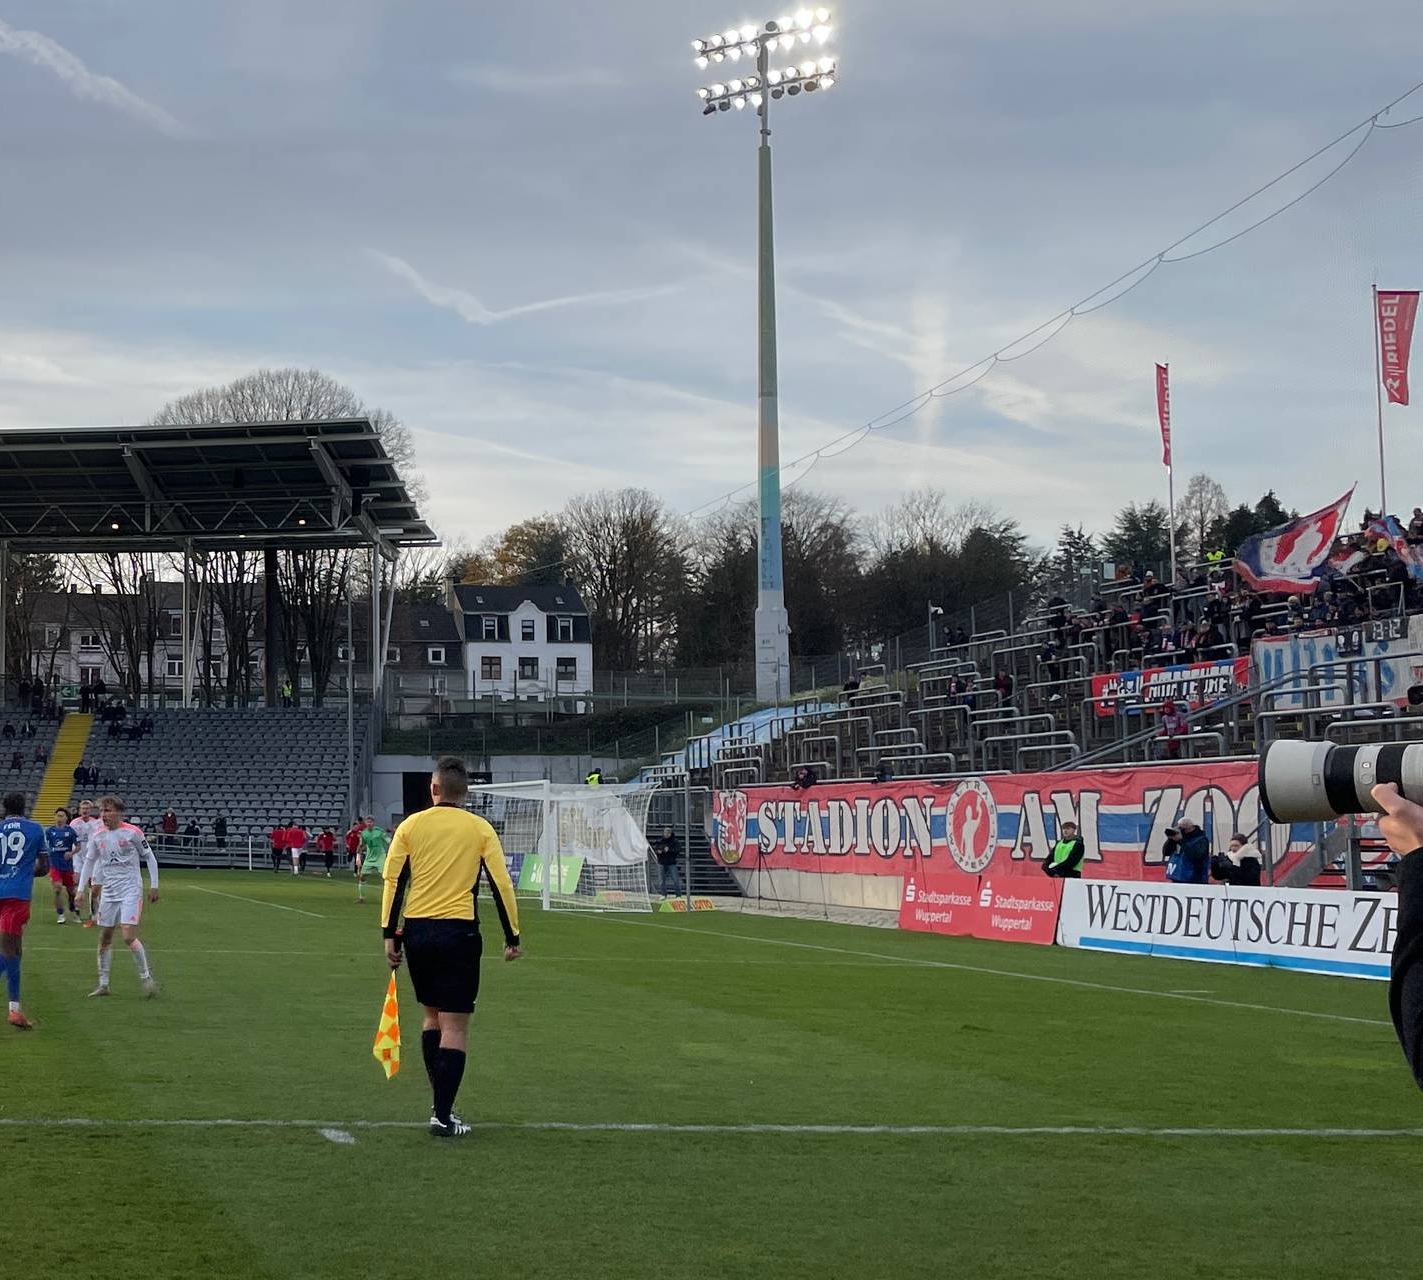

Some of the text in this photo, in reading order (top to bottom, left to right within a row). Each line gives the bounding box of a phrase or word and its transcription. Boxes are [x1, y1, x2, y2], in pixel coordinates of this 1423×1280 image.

[758, 796, 935, 857] STADION
[1010, 789, 1103, 863] AM
[917, 889, 972, 906] Stadtsparkasse
[994, 894, 1055, 912] Stadtsparkasse
[915, 908, 953, 924] Wuppertal
[991, 914, 1033, 931] Wuppertal
[1086, 883, 1341, 950] WESTDEUTSCHE
